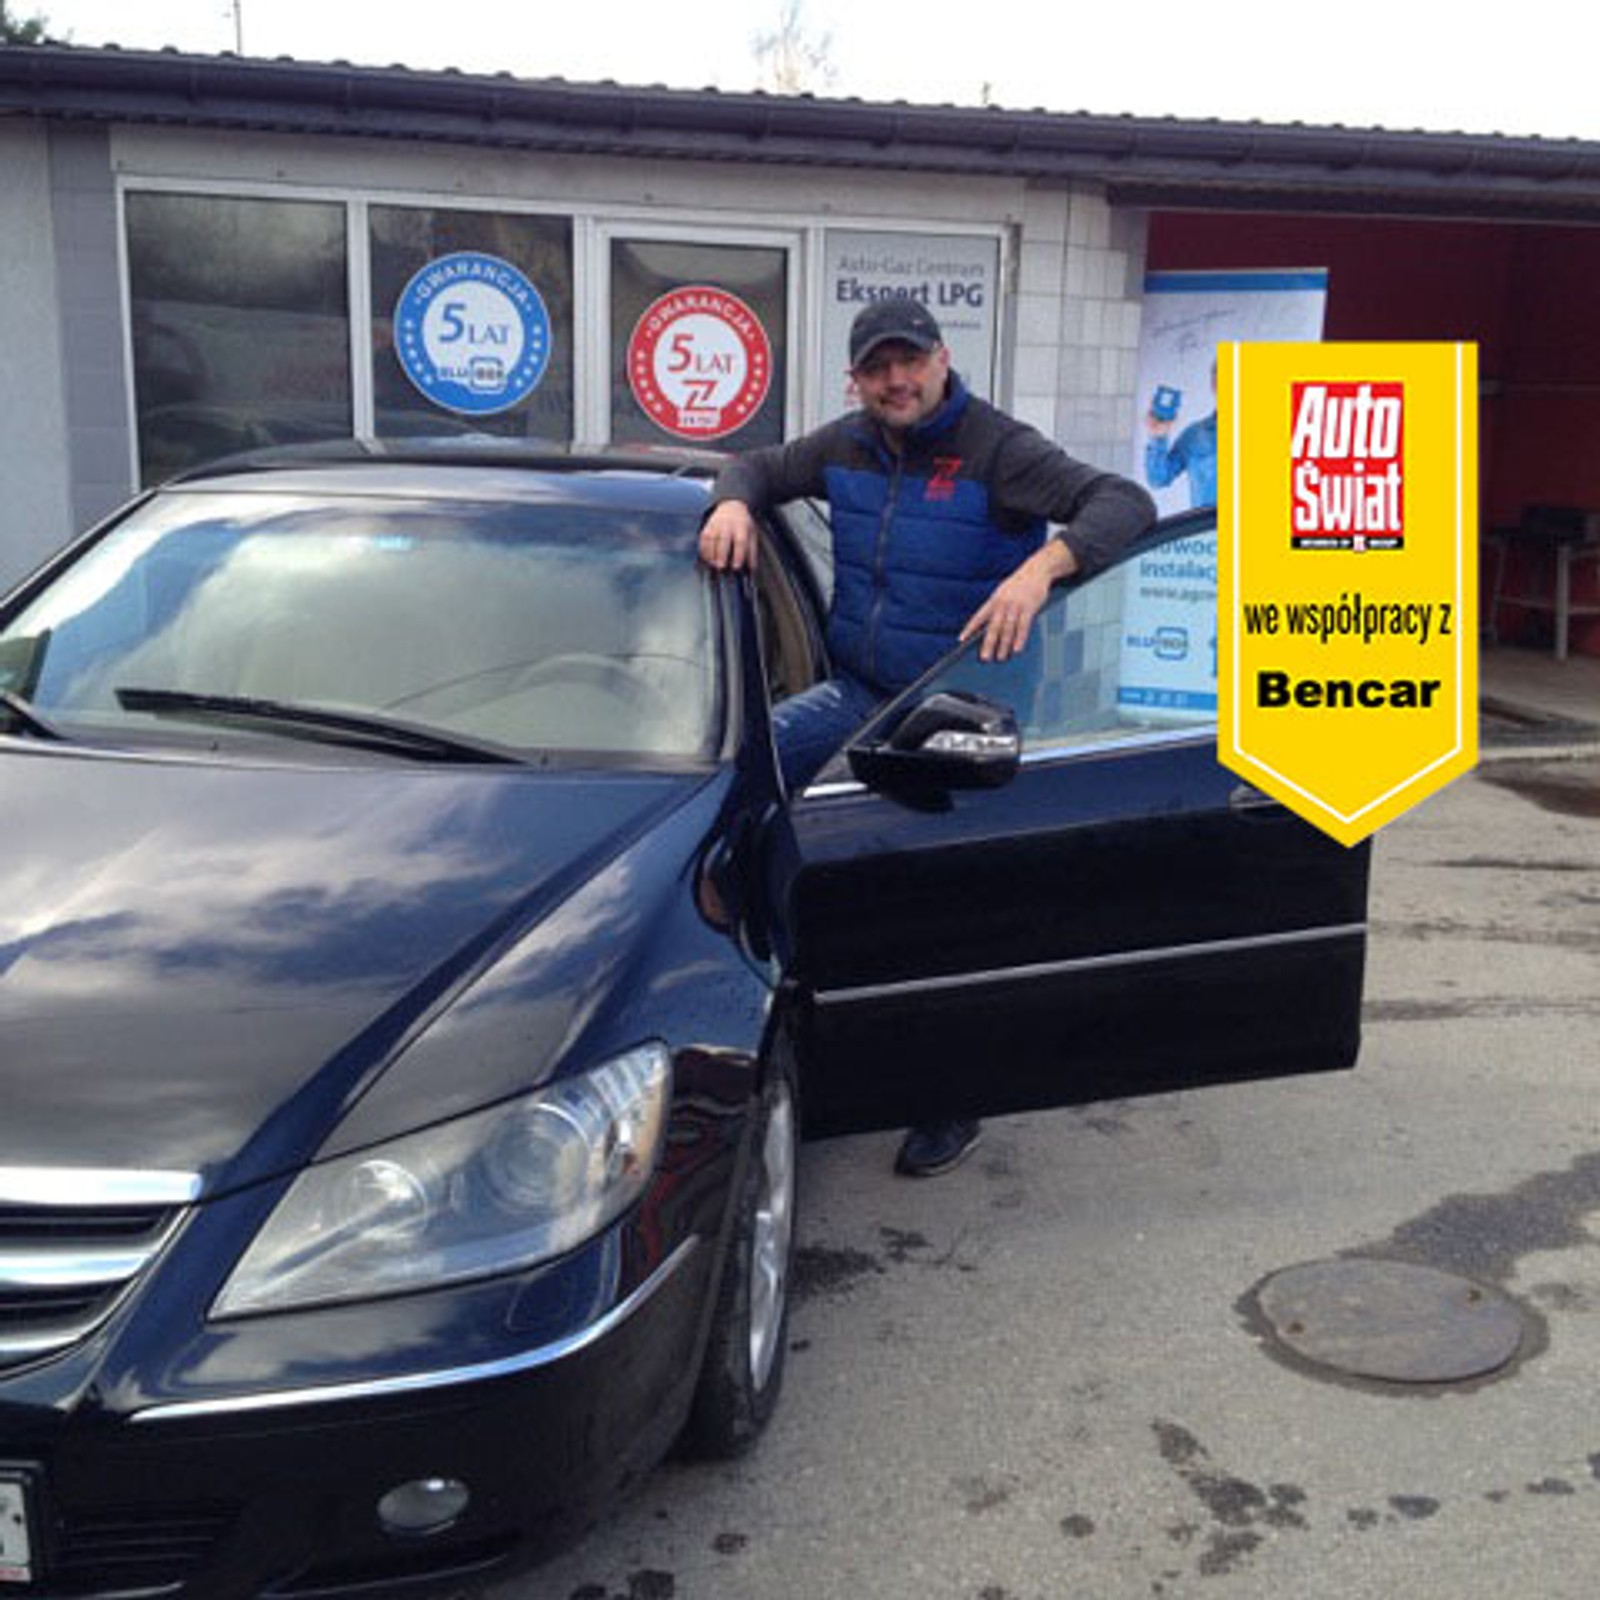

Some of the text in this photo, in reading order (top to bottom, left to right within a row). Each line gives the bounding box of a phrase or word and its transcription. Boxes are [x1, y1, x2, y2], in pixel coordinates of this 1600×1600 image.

[416, 262, 529, 301] GWARANCJA
[938, 281, 984, 307] LPG
[439, 303, 509, 344] 5 LAT
[668, 334, 733, 375] 5 LAT
[1152, 541, 1217, 556] owoc
[1140, 559, 1217, 584] instalac
